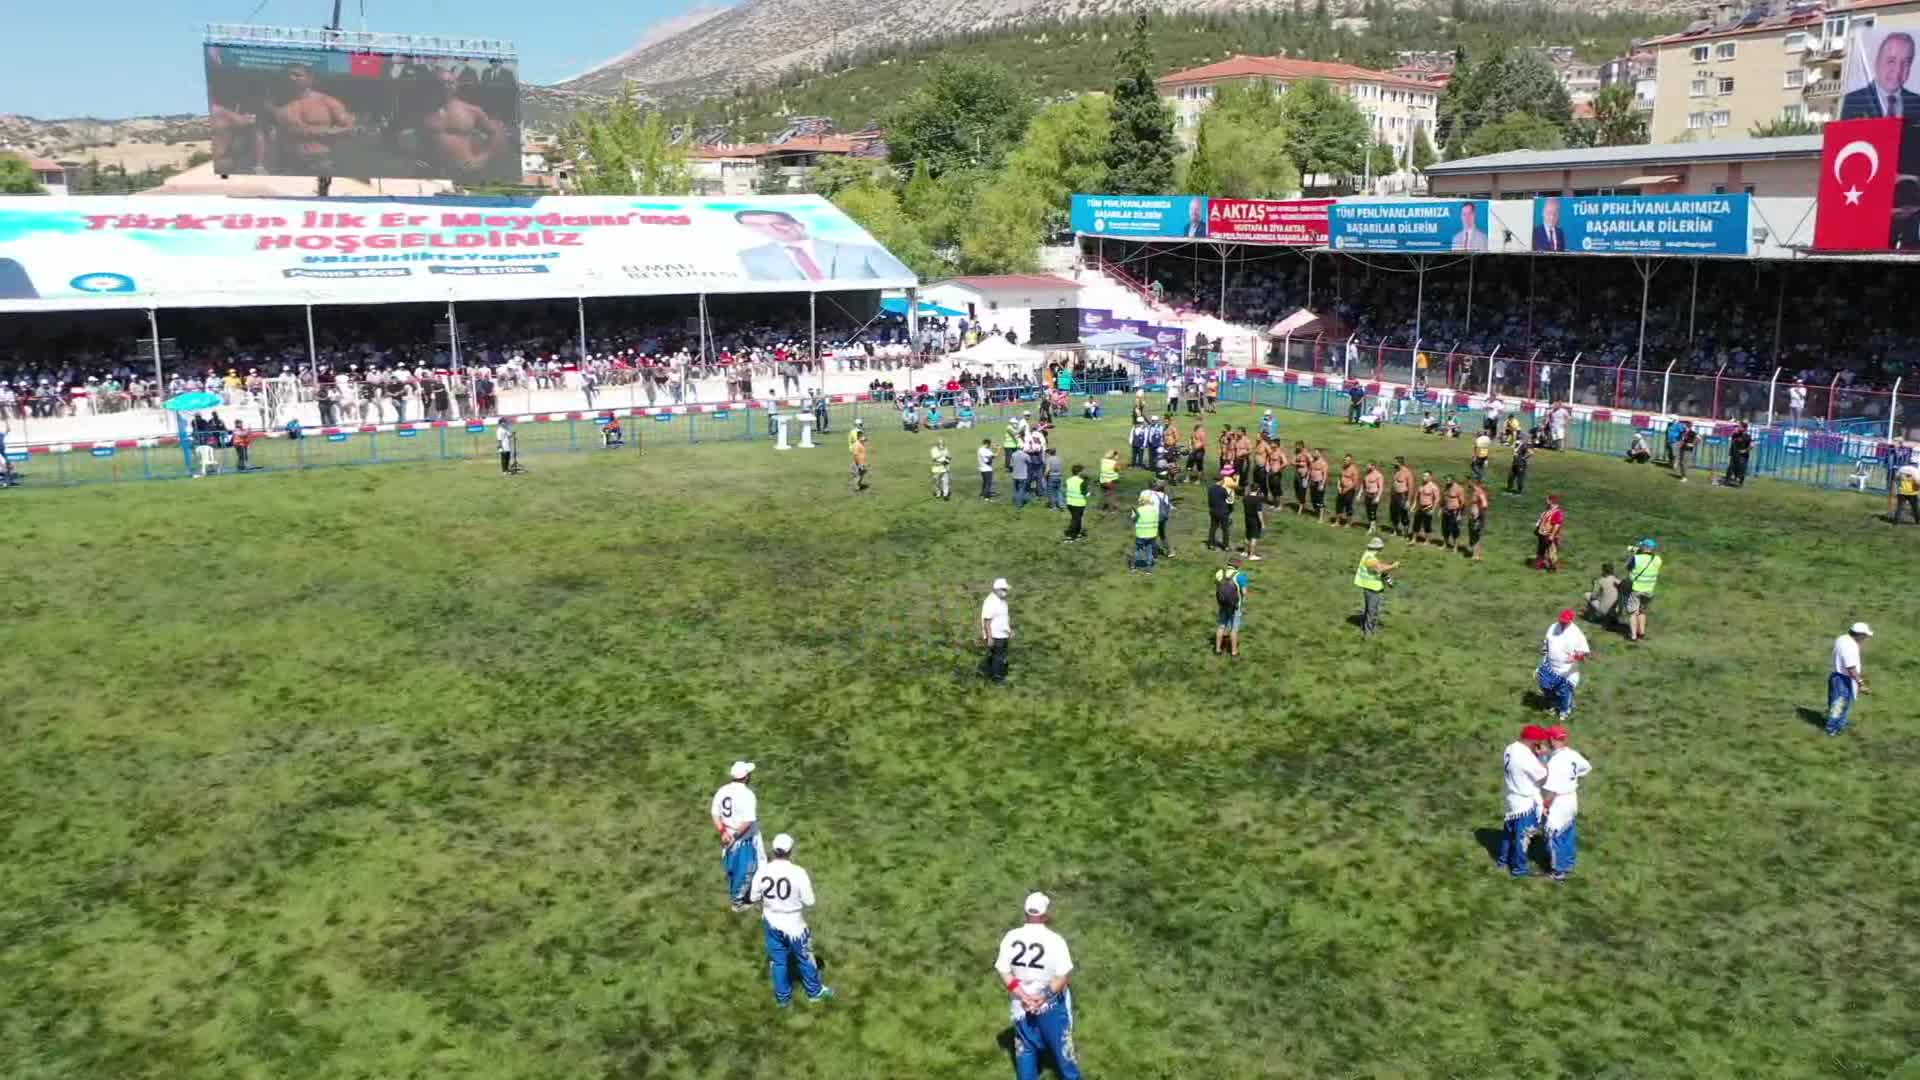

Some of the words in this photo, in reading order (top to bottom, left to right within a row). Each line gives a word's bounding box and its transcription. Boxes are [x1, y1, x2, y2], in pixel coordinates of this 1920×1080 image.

[1222, 203, 1266, 222] AKTAŞ
[1336, 206, 1355, 218] TÜM
[1357, 205, 1450, 218] PEHLİVANLARIMIZA
[1573, 200, 1599, 216] TÜM
[1601, 199, 1731, 215] PEHLİVANLARIMIZA
[380, 213, 429, 228] Er
[440, 212, 692, 230] Meydanı'na
[1346, 222, 1396, 235] BAŞARILAR
[1398, 220, 1438, 233] DİLERİM
[1586, 219, 1655, 236] BAŞARILAR
[1658, 216, 1713, 233] DİLERİM
[255, 229, 584, 253] HOŞGELDİNİZ
[721, 796, 733, 818] 9
[760, 876, 792, 900] 20
[1010, 940, 1045, 970] 22
